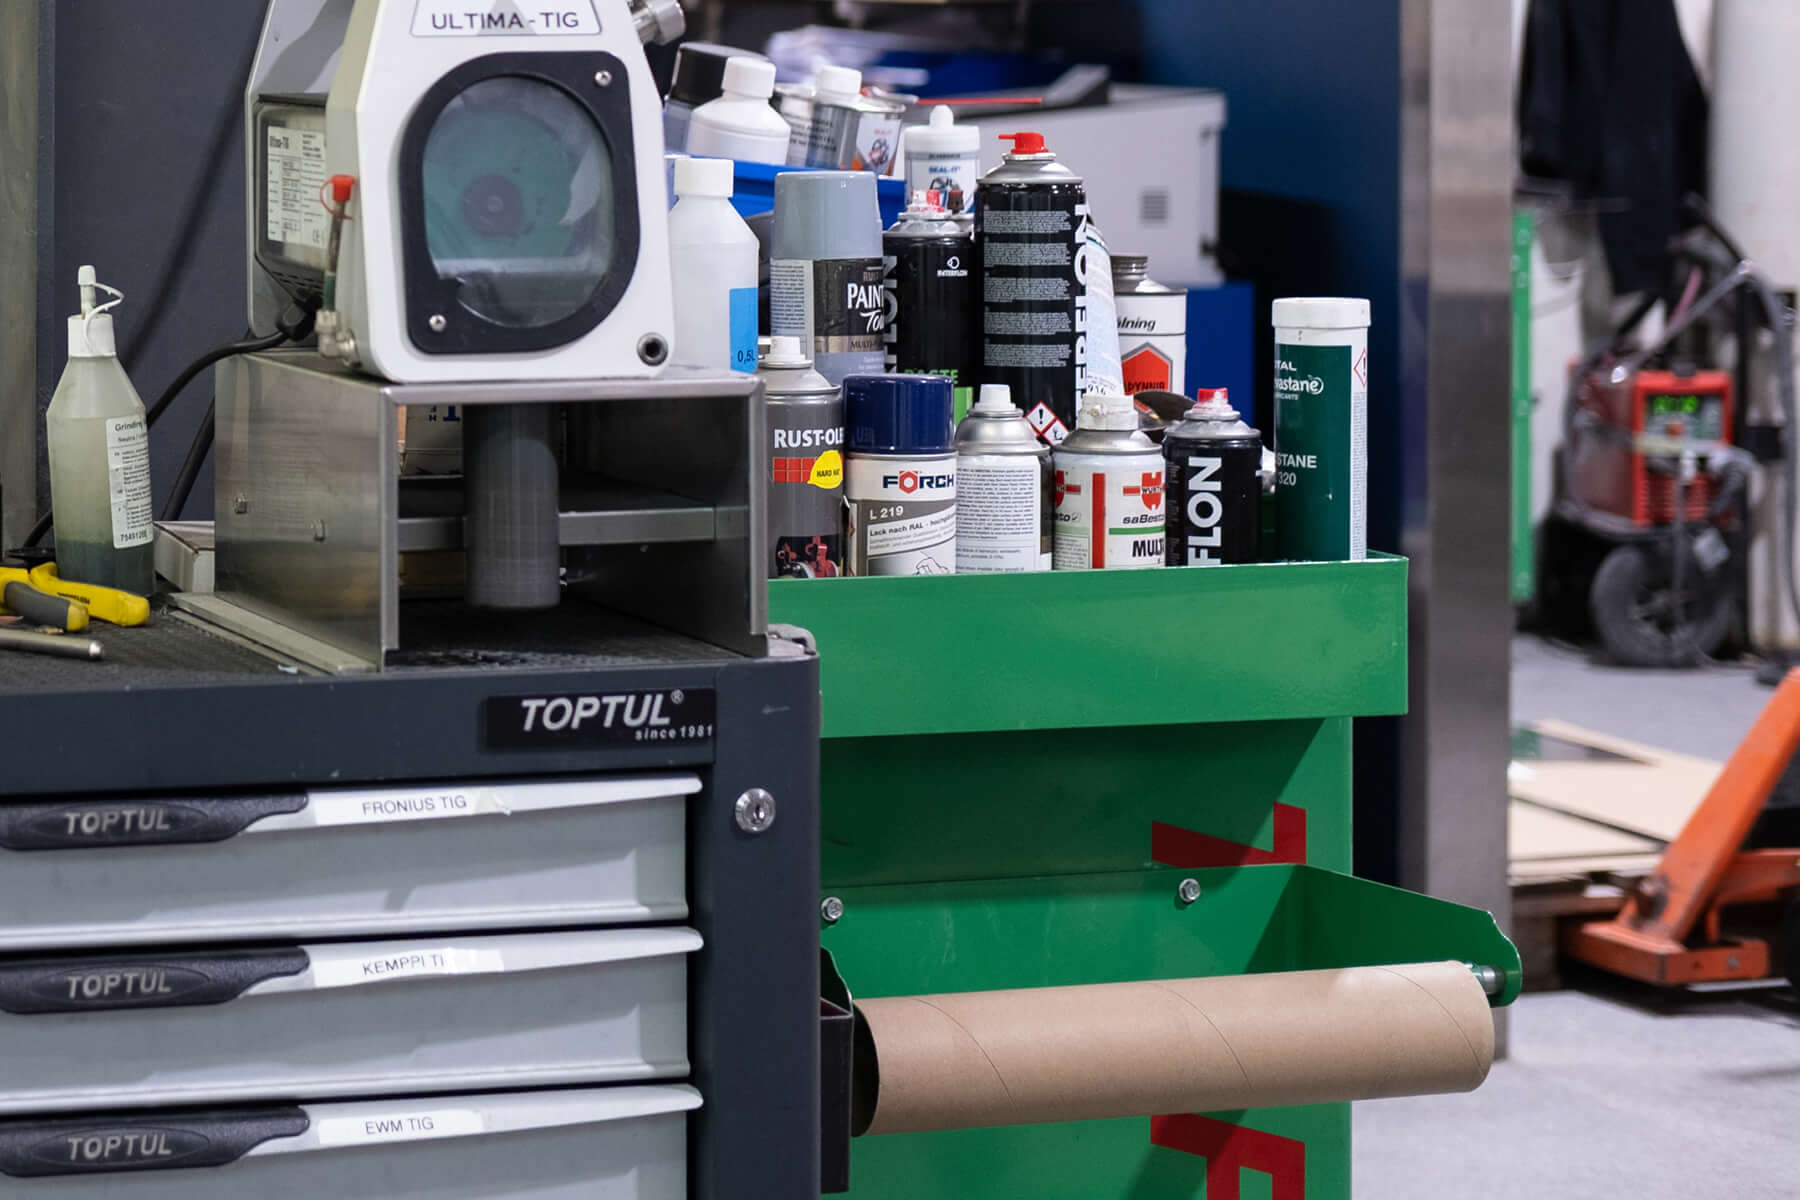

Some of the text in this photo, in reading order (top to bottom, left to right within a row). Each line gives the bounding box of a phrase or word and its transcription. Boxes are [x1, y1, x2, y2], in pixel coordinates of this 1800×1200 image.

[870, 505, 904, 520] L 219
[635, 724, 713, 741] since 1981
[361, 795, 467, 816] FRONIUS TIG
[65, 809, 171, 835] TOPTUL
[362, 953, 445, 976] KEMPPI TI
[66, 971, 172, 999] TOPTUL
[364, 1116, 434, 1135] EWM TIG
[67, 1133, 172, 1161] TOPTUL
